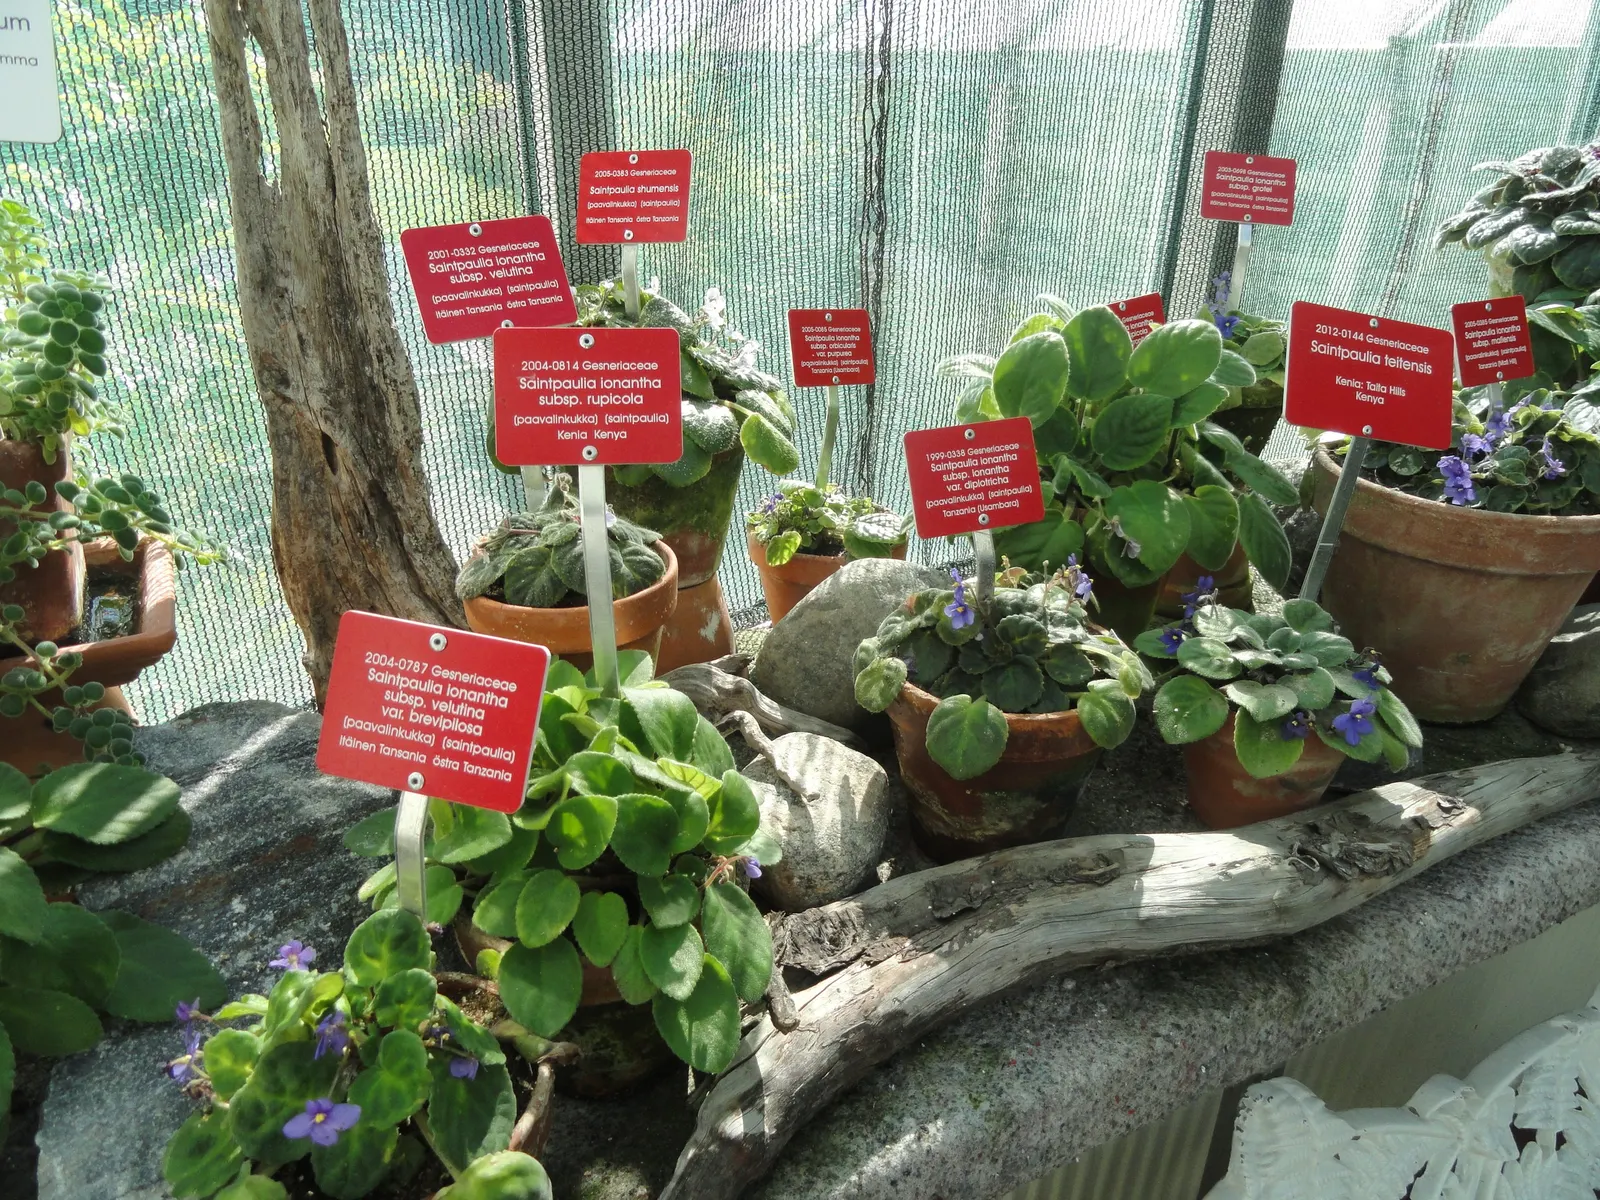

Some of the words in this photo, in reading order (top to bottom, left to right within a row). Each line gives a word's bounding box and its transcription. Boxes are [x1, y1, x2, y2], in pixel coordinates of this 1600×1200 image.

[1216, 173, 1254, 183] Saintpaulia
[1255, 177, 1286, 186] ionantha
[1247, 170, 1285, 178] Gesneriaceae
[590, 186, 635, 195] Saintpaulia
[637, 184, 679, 193] shumensis
[1229, 183, 1250, 191] subsp.
[587, 201, 637, 209] (paavalinkukka)
[641, 200, 680, 208] (saintpaulia)
[1211, 191, 1253, 200] (paavalinkukka)
[1256, 196, 1288, 204] (saintpaulia)
[427, 247, 476, 260] 2001-0332
[478, 241, 540, 254] Gesneriaceae
[429, 258, 493, 274] Saintpaulia
[496, 252, 546, 265] ionantha
[450, 272, 486, 284] subsp.
[490, 266, 533, 279] velutina
[432, 287, 502, 304] (paavalinkukka)
[507, 280, 559, 294] (saintpaulia)
[435, 309, 465, 318] Itäinen
[467, 303, 502, 315] Tansania
[507, 300, 526, 309] östra
[528, 295, 563, 306] Tanzania
[1122, 311, 1154, 323] Gesneriaceae
[1488, 316, 1518, 324] Gesneriaceae
[1131, 328, 1148, 338] picola
[1315, 324, 1364, 341] 2012-0144
[1366, 334, 1429, 355] Gesneriaceae
[1465, 328, 1495, 339] Saintpaulia
[1497, 325, 1521, 334] ionantha
[1473, 340, 1490, 348] subsp.
[1501, 346, 1526, 355] (saintpaulia)
[1311, 340, 1381, 365] Saintpaulia
[1384, 355, 1432, 374] teitensis
[522, 361, 579, 371] 2004-0814
[582, 361, 658, 370] Gesneriaceae
[520, 377, 596, 391] Saintpaulia
[601, 377, 661, 389] ionantha
[1335, 376, 1364, 389] Kenia:
[1366, 381, 1387, 393] Taita
[1390, 386, 1406, 396] Hills
[539, 394, 582, 407] subsp.
[587, 393, 644, 406] rupicola
[1355, 392, 1384, 405] Kenya
[514, 415, 598, 426] (paavalinkukka)
[605, 414, 669, 425] (saintpaulia)
[557, 430, 587, 440] Kenia
[594, 430, 627, 440] Kenya
[926, 450, 965, 461] 1999-0338
[967, 443, 1019, 455] Gesneriaceae
[931, 458, 978, 472] Saintpaulia
[980, 453, 1017, 464] ionantha
[943, 472, 970, 482] subsp.
[972, 465, 1009, 477] ionantha
[947, 483, 962, 492] var.
[964, 476, 1009, 489] diplotricha
[926, 492, 984, 508] (paavalinkukka)
[988, 485, 1032, 499] (saintpaulia)
[943, 506, 976, 517] Tanzania
[978, 499, 1019, 513] (Usambara)
[365, 652, 429, 674] 2004-0787
[431, 665, 517, 693] Gesneriaceae
[368, 668, 443, 695] Saintpaulia
[446, 685, 508, 709] ionantha
[384, 689, 427, 709] subsp.
[431, 700, 485, 720] velutina
[381, 705, 405, 720] var.
[409, 708, 483, 737] brevipilosa
[343, 715, 435, 748] (paavalinkukka)
[442, 736, 516, 764] (saintpaulia)
[339, 735, 376, 753] Itäinen
[379, 743, 427, 764] Tansania
[432, 755, 460, 771] östra
[463, 761, 512, 782] Tanzania
